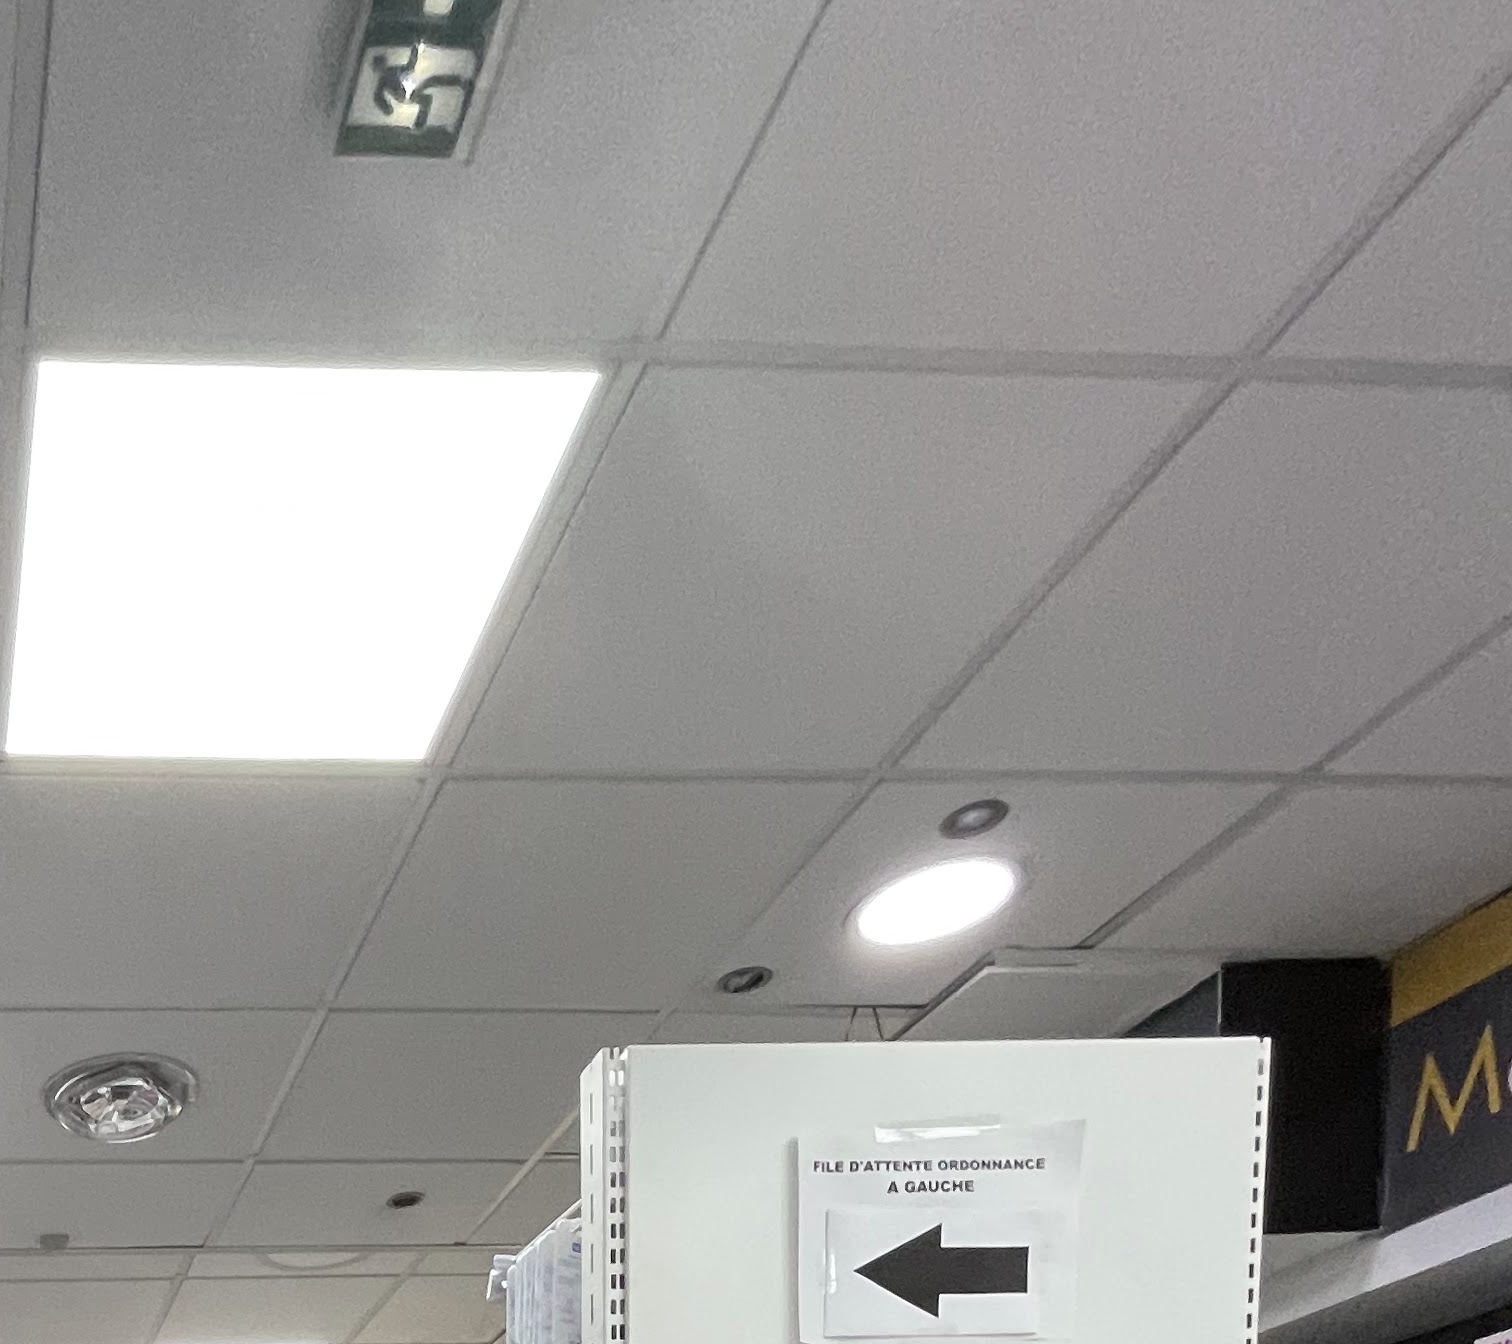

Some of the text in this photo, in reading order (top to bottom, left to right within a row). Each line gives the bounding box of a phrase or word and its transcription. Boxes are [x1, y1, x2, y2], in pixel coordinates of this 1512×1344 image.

[813, 1157, 1046, 1173] FILE D'ATTENTE ORDONNANCE
[887, 1179, 975, 1193] A GAUCHE
